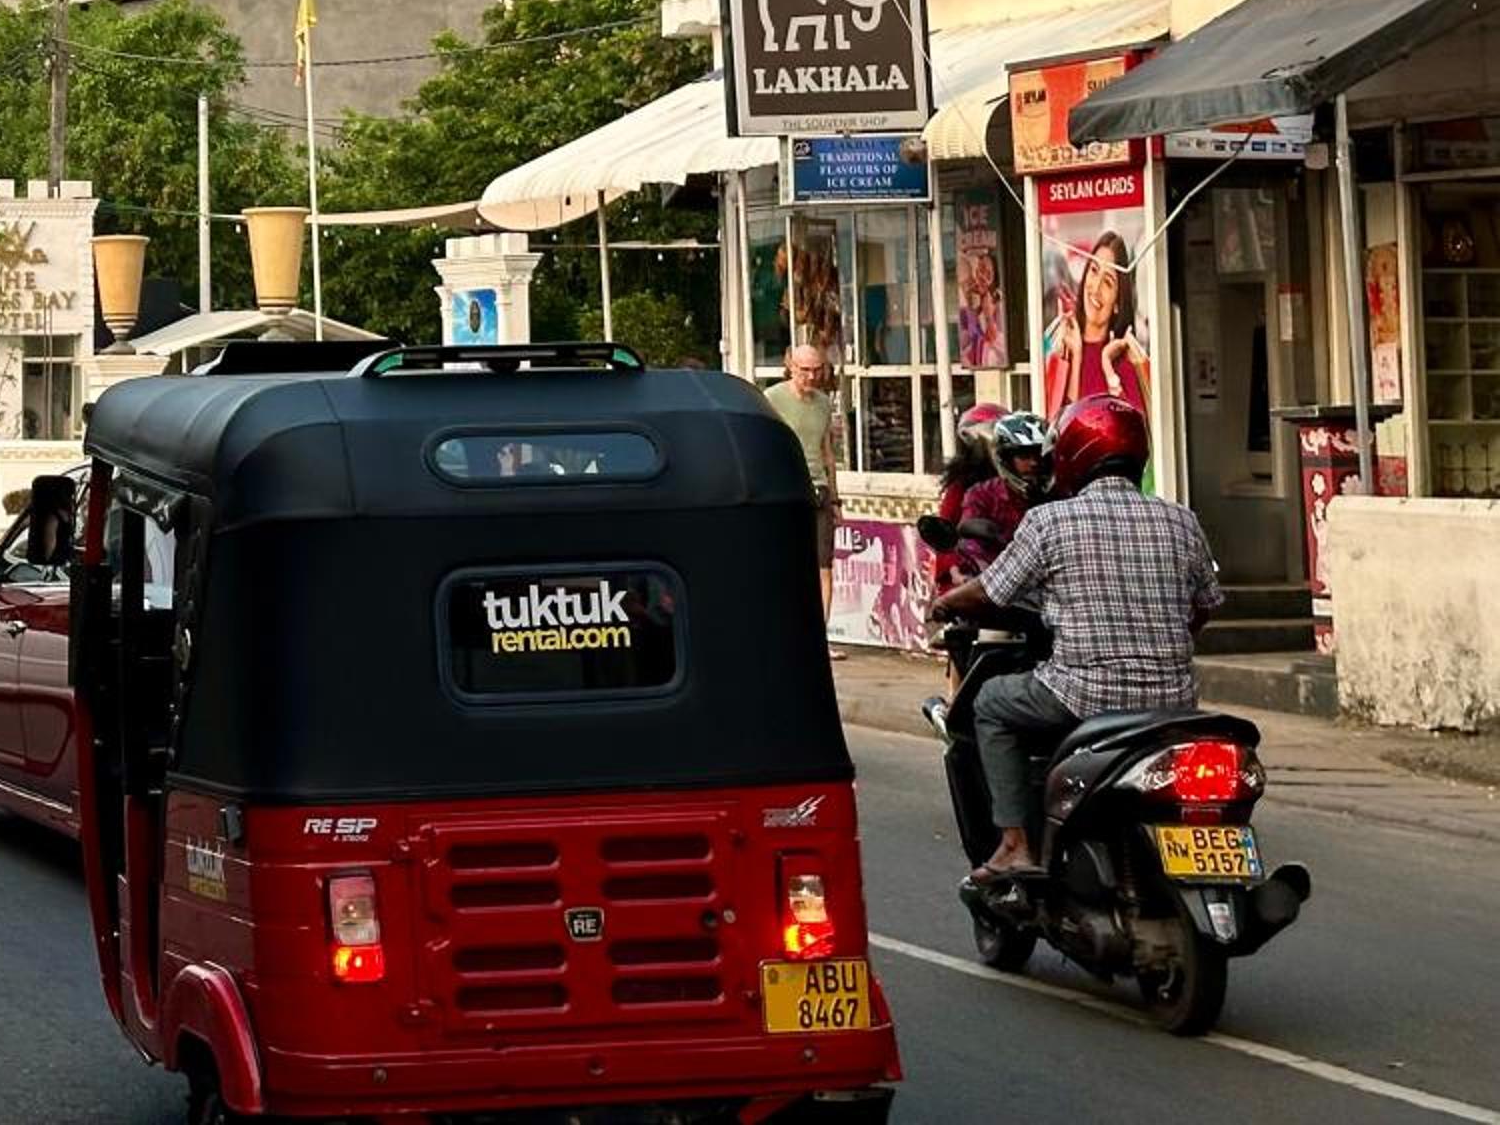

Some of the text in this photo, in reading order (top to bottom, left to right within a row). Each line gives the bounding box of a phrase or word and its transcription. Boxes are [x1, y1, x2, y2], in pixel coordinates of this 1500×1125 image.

[753, 64, 909, 95] LAKHALA
[860, 115, 888, 127] SHOP
[820, 152, 899, 162] TRADITIONAL
[820, 164, 898, 175] FLAVOURS OF
[827, 177, 893, 188] ICE CREAM
[1050, 176, 1135, 202] SEYLAN CARDS
[33, 292, 76, 310] BAY
[483, 581, 630, 629] tuktuk
[492, 626, 632, 654] rental.com
[303, 818, 377, 834] RE SP
[1192, 829, 1240, 850] BEG
[1165, 842, 1189, 858] NW
[1194, 852, 1245, 873] 5157
[573, 918, 597, 934] RE
[806, 964, 857, 994] ABU
[799, 998, 859, 1028] 8467
